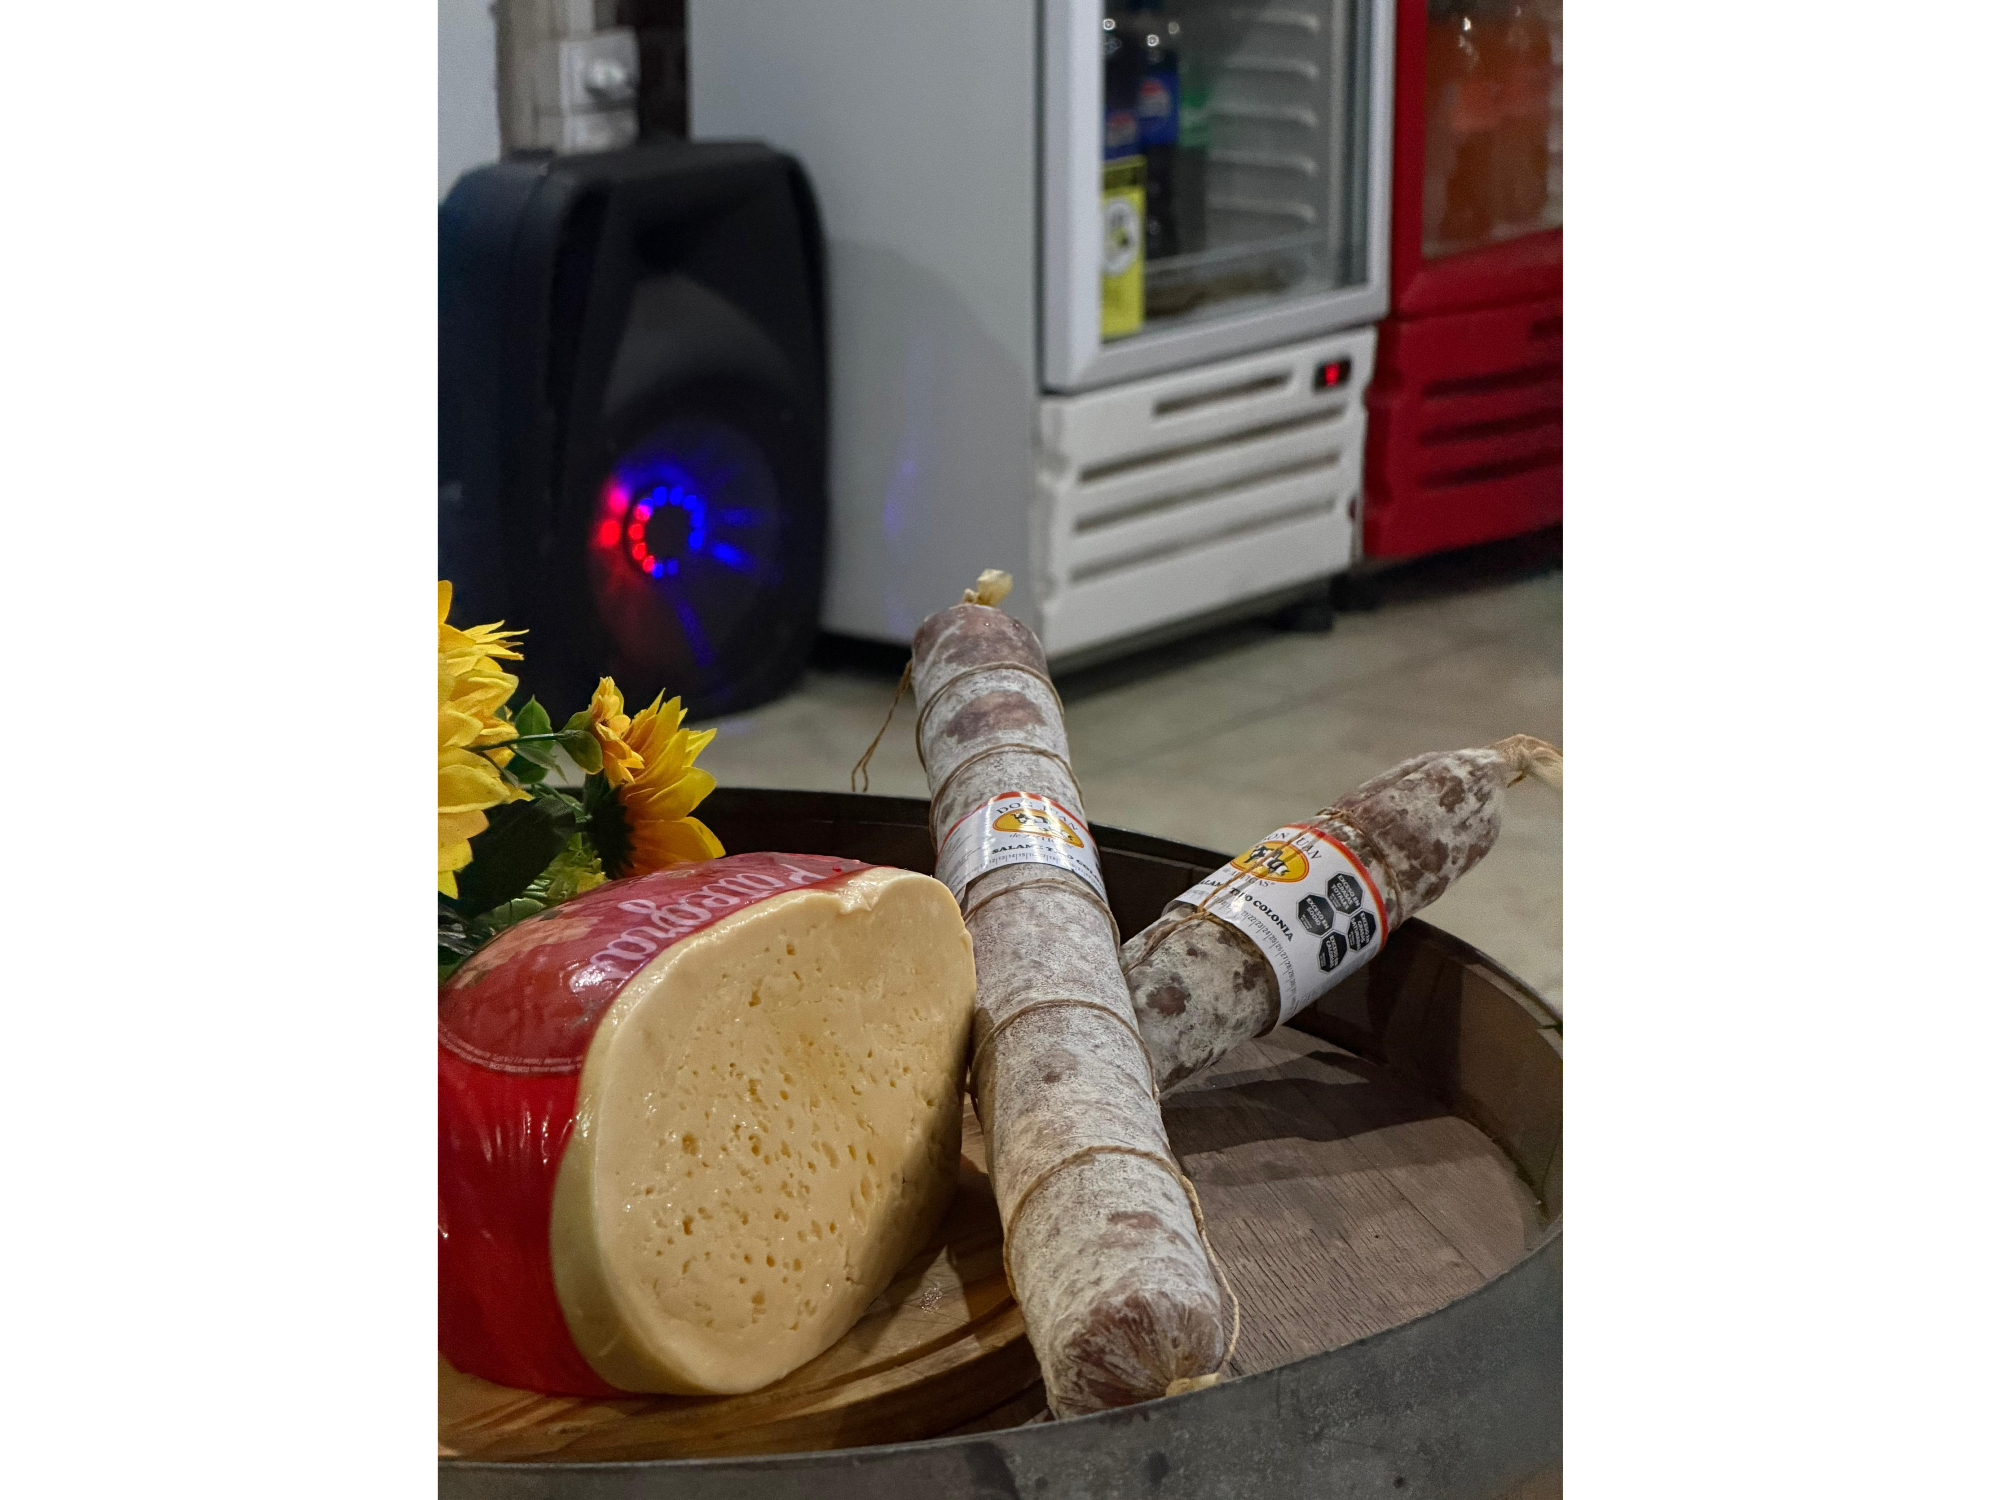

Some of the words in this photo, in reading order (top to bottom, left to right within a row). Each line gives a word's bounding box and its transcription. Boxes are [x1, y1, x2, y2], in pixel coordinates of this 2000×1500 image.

[1263, 832, 1290, 841] ON
[1295, 837, 1322, 859] UAN
[1231, 870, 1270, 888] ATIGAS
[1338, 874, 1355, 897] EXCESO
[1352, 896, 1361, 907] EN
[1331, 883, 1349, 910] TOTALES
[1336, 882, 1353, 905] GRASAS
[1200, 879, 1231, 888] ALAM
[1253, 900, 1294, 942] COLONIA
[1306, 897, 1324, 920] EXCESO
[1321, 919, 1330, 930] EN
[1306, 906, 1321, 926] SODIO
